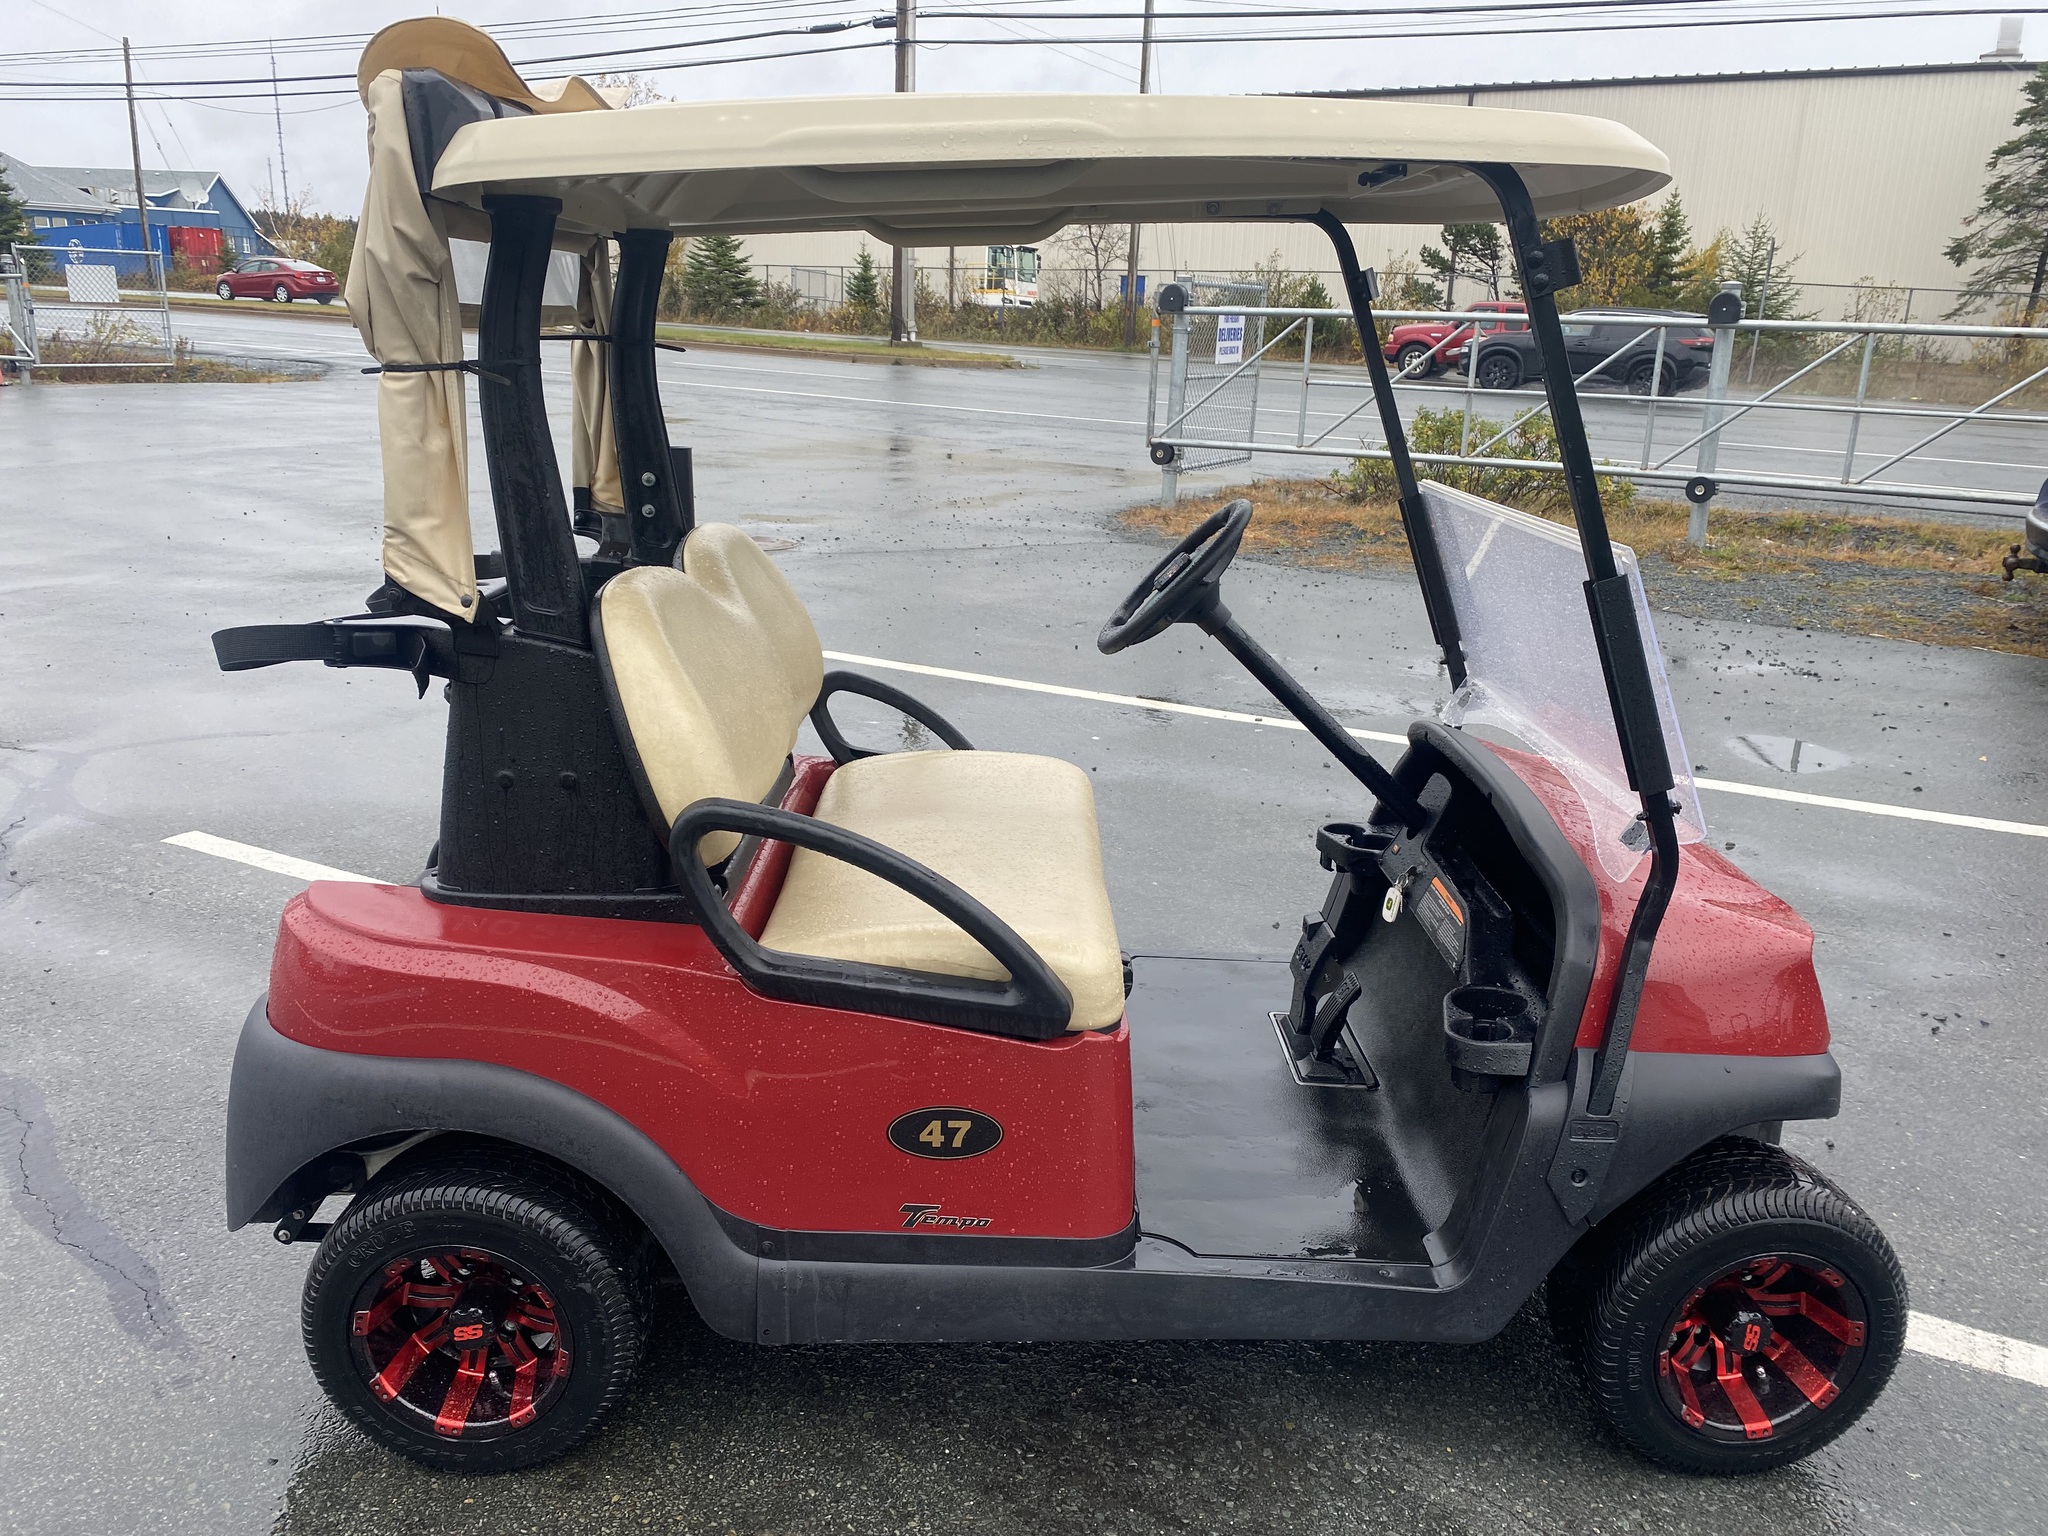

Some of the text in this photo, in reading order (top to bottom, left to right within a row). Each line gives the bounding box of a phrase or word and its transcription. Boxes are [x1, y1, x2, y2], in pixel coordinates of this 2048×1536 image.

[1218, 327, 1243, 342] DELIVERIES
[919, 1120, 972, 1147] 47
[899, 1203, 994, 1230] Tempo
[453, 1323, 483, 1341] SS
[1743, 1323, 1761, 1351] SS
